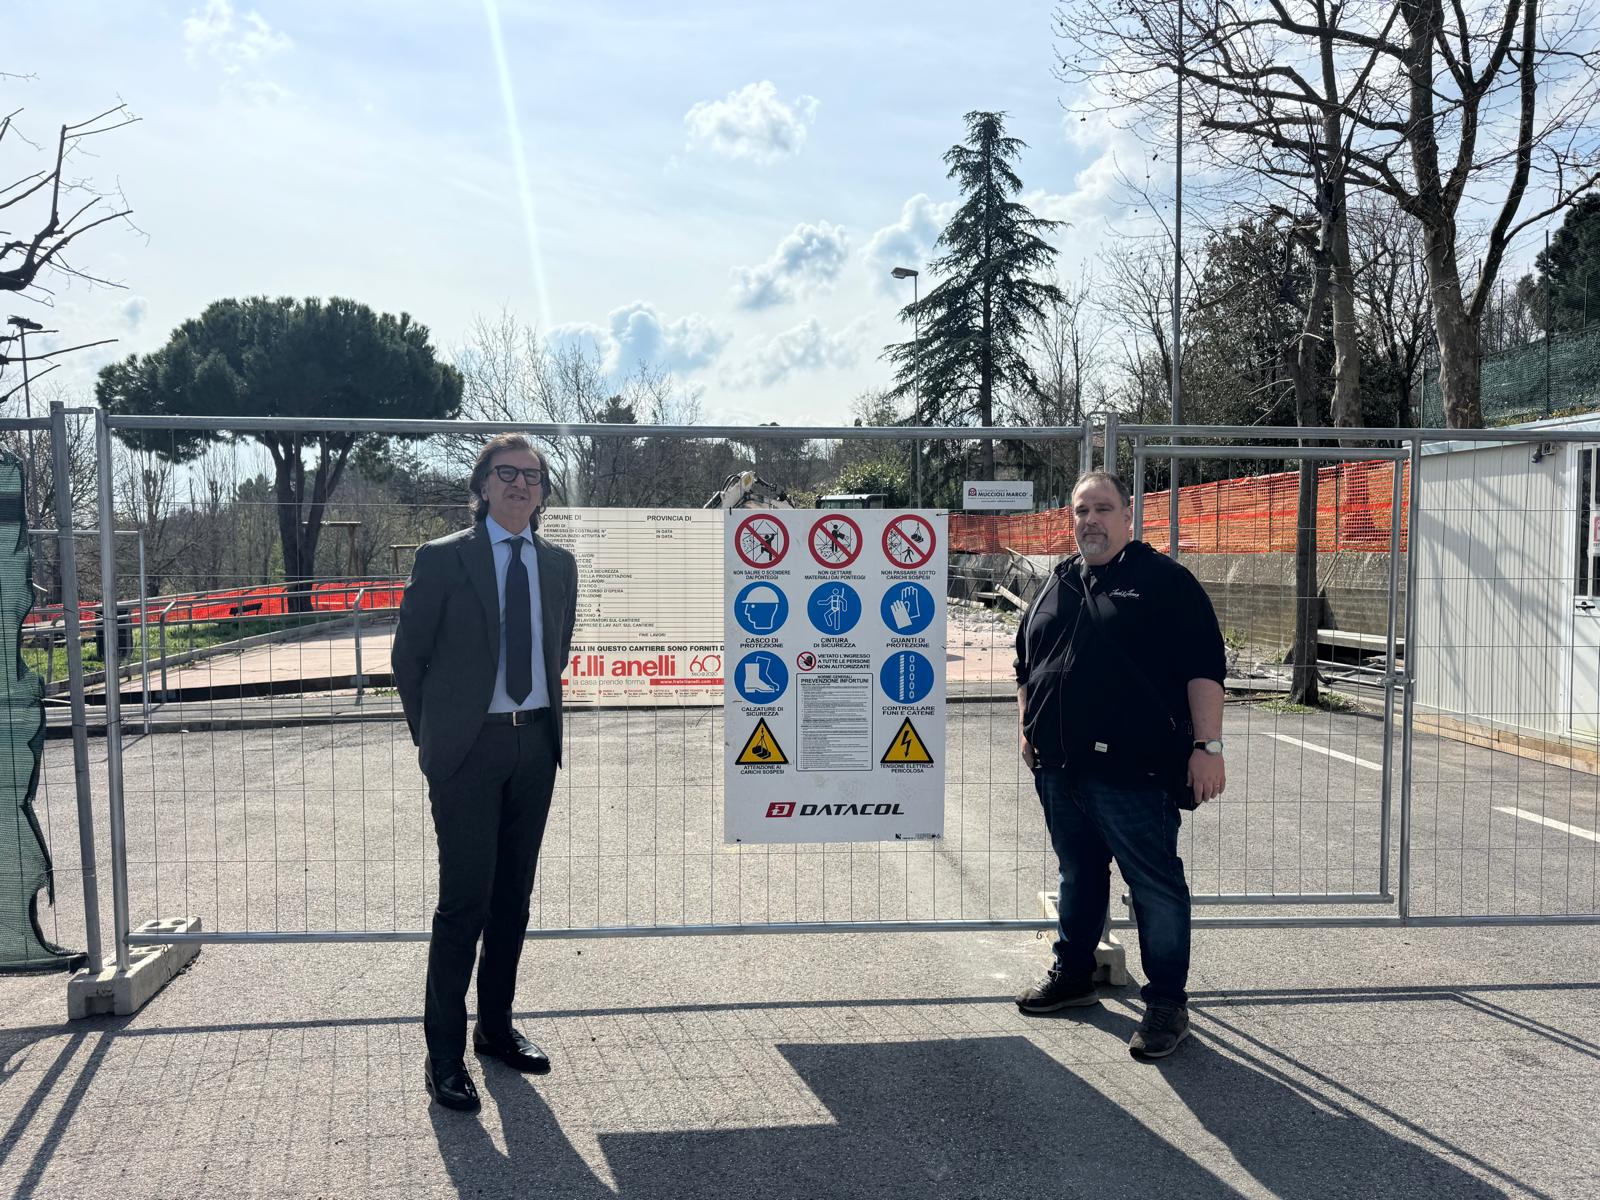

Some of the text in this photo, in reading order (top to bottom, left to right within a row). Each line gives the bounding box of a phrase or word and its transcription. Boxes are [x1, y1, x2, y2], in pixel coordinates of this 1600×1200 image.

[571, 655, 605, 677] f.lli
[611, 655, 676, 677] anelli
[598, 679, 624, 687] prende
[800, 803, 905, 816] DATACOL
